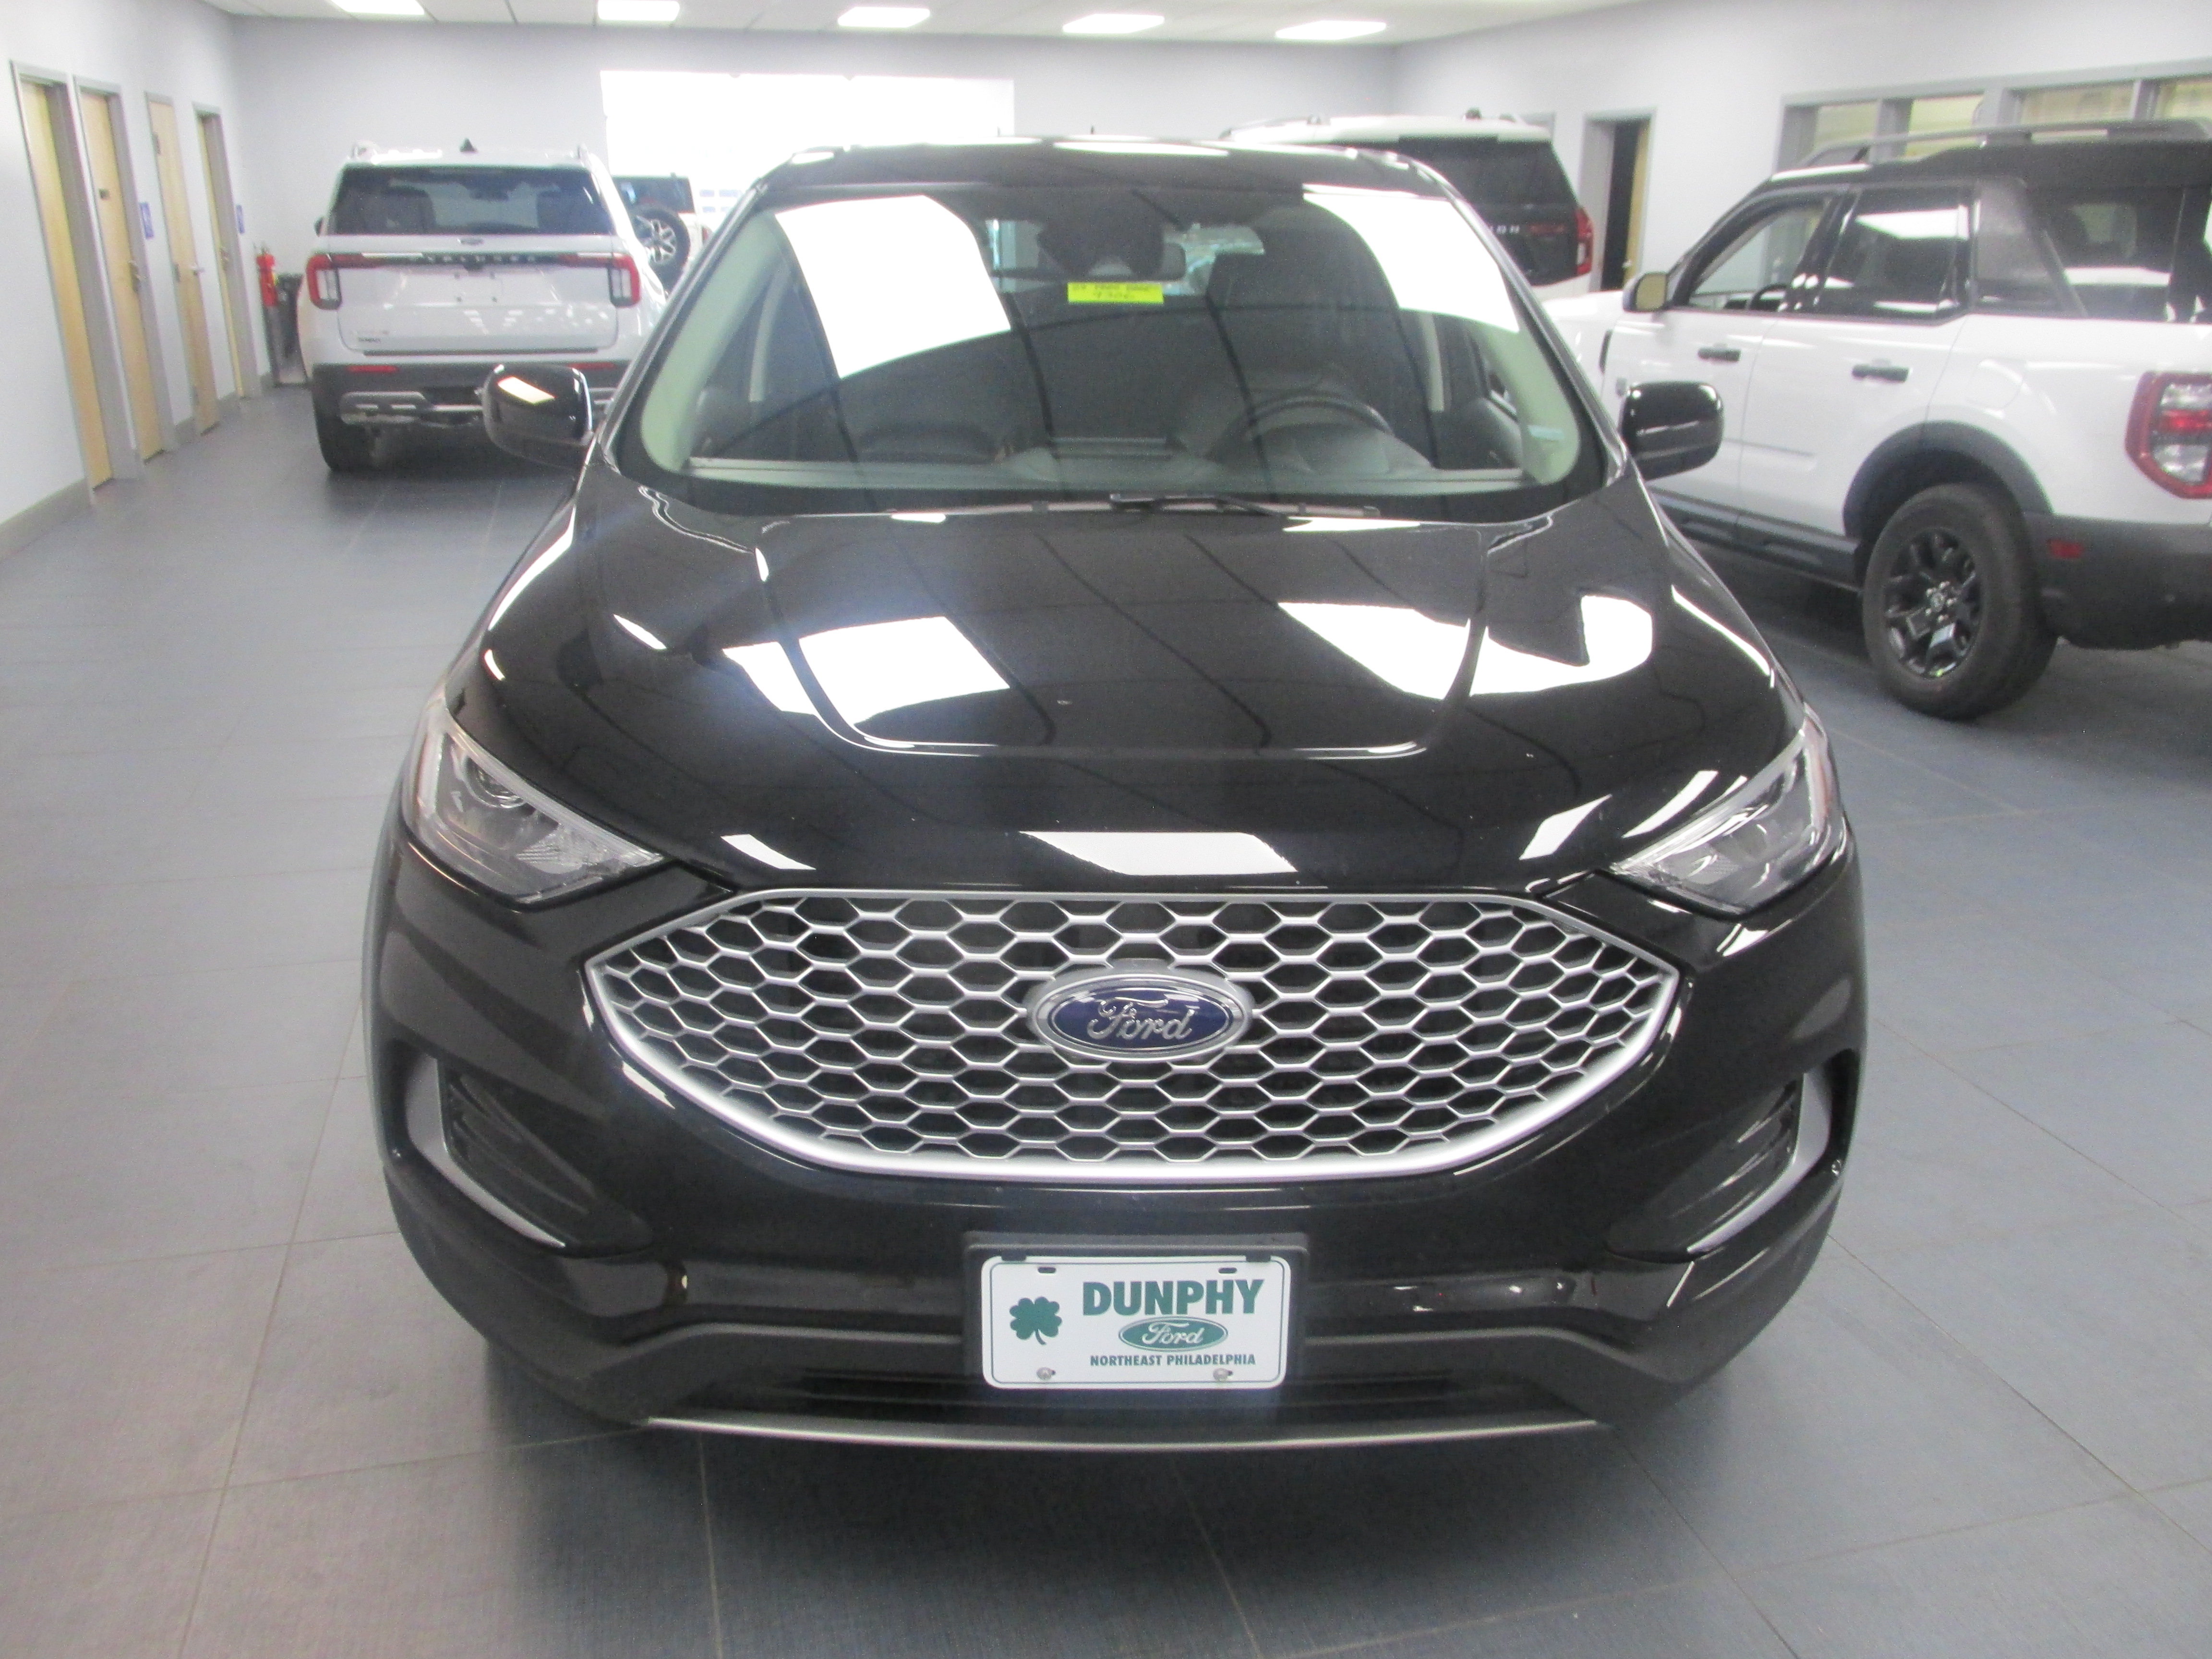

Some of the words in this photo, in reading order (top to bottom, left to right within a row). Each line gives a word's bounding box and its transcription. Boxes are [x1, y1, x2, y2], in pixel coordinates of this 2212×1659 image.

[1087, 996, 1194, 1040] Ford
[1082, 1279, 1265, 1316] DUNPHY
[1142, 1322, 1204, 1345] Ford
[1090, 1355, 1162, 1367] NORTHEAST
[1166, 1354, 1256, 1366] PHILADELPHIA
